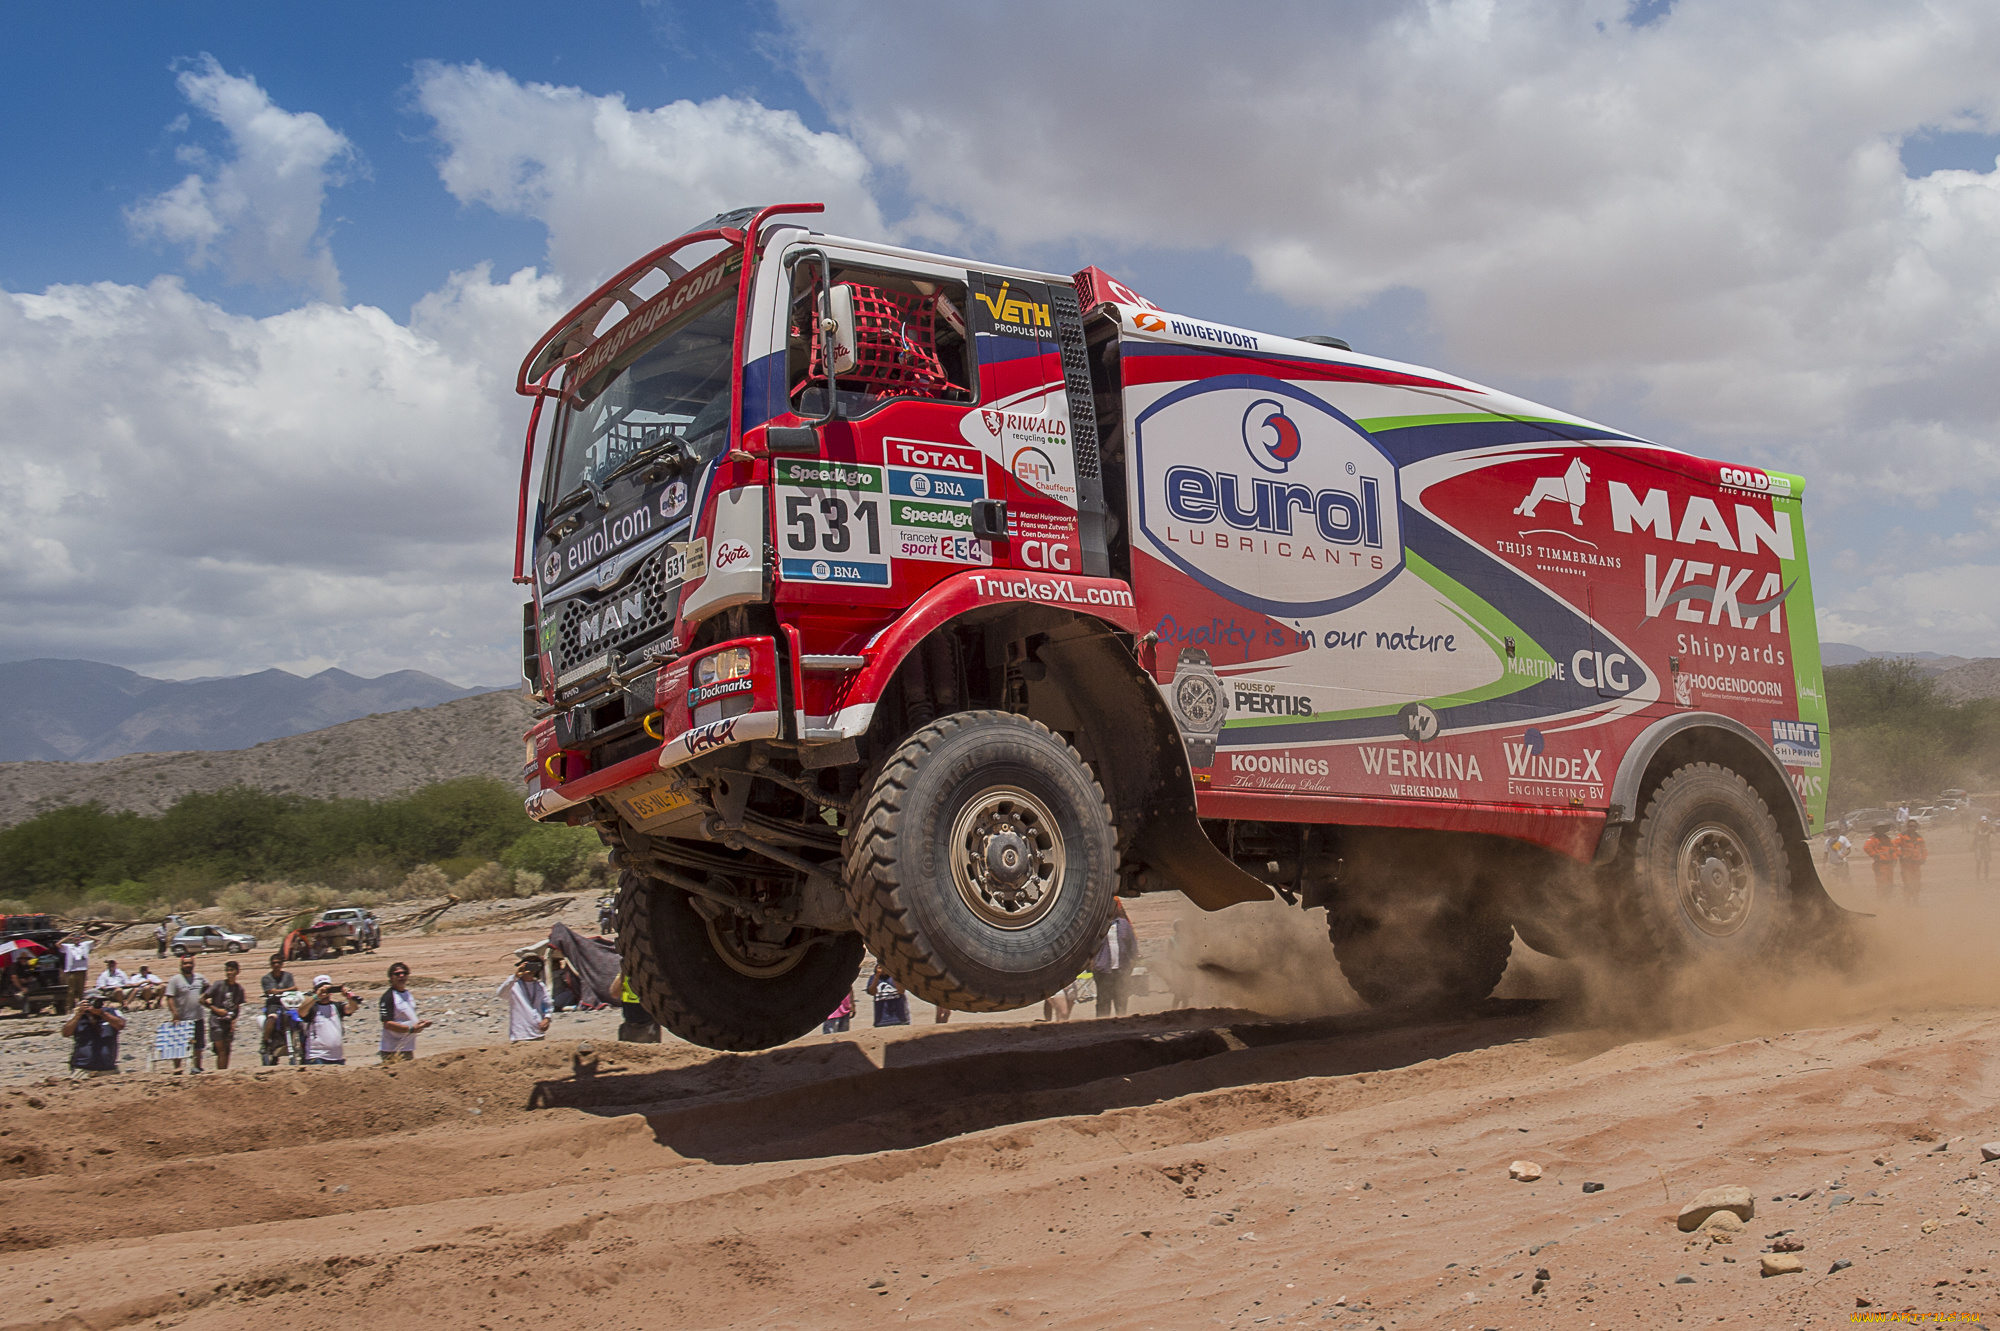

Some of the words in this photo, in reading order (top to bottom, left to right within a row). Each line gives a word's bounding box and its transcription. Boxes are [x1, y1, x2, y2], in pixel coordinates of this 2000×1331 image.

[975, 281, 1051, 327] VETH
[574, 263, 725, 386] vekagroup.com
[994, 323, 1052, 338] PROPULSION
[1170, 320, 1259, 351] HUIGEVOORT
[1007, 413, 1066, 435] RIWALD
[1012, 433, 1046, 444] recycling
[896, 444, 974, 470] TOTAL
[789, 465, 873, 486] SpeedAgro
[1018, 462, 1050, 481] 247
[1720, 467, 1768, 489] GOLD
[934, 481, 965, 497] BNA
[1036, 481, 1075, 493] Chauffeurs
[1719, 486, 1738, 495] DISC
[1742, 490, 1767, 500] BRAKE
[1164, 465, 1383, 549] eurol
[786, 496, 881, 554] 531
[1021, 520, 1037, 528] Frans
[1608, 480, 1796, 560] MAN
[567, 504, 651, 570] eurol.com
[900, 530, 939, 543] francetv
[1022, 530, 1037, 538] Coen
[1037, 531, 1060, 540] Donkers
[715, 544, 751, 569] Exota
[901, 543, 937, 556] sport
[1021, 540, 1072, 571] CIG
[1167, 526, 1384, 570] LUBRICANTS
[1496, 540, 1533, 558] THIJS
[1537, 546, 1621, 569] TIMMERMANS
[667, 554, 685, 579] 531
[833, 566, 861, 579] BNA
[968, 574, 1134, 607] TrucksXL.com
[1645, 554, 1781, 633] VEKA
[580, 591, 643, 647] MAN
[1156, 614, 1256, 660] Quality
[1265, 619, 1286, 647] is
[1294, 620, 1316, 649] in
[1324, 627, 1368, 649] our
[1376, 625, 1457, 652] nature
[1677, 633, 1785, 666] Shipyards
[1508, 656, 1566, 681] MARITIME
[1572, 649, 1630, 691] CIG
[701, 678, 752, 700] Dockmarks
[1234, 682, 1262, 693] HOUSE
[1264, 684, 1276, 693] OF
[1690, 673, 1783, 697] HOOGENDOORN
[684, 718, 738, 756] VEKA
[1772, 720, 1818, 742] NMT
[1358, 746, 1484, 782] WERKINA
[1775, 747, 1820, 758] SHIPPING
[1230, 774, 1255, 788] The
[1256, 776, 1297, 797] Wedding
[1298, 776, 1331, 791] Palace
[1390, 783, 1458, 799] WERKENDAM
[1508, 781, 1586, 799] ENGINEERING
[1590, 786, 1604, 800] BV
